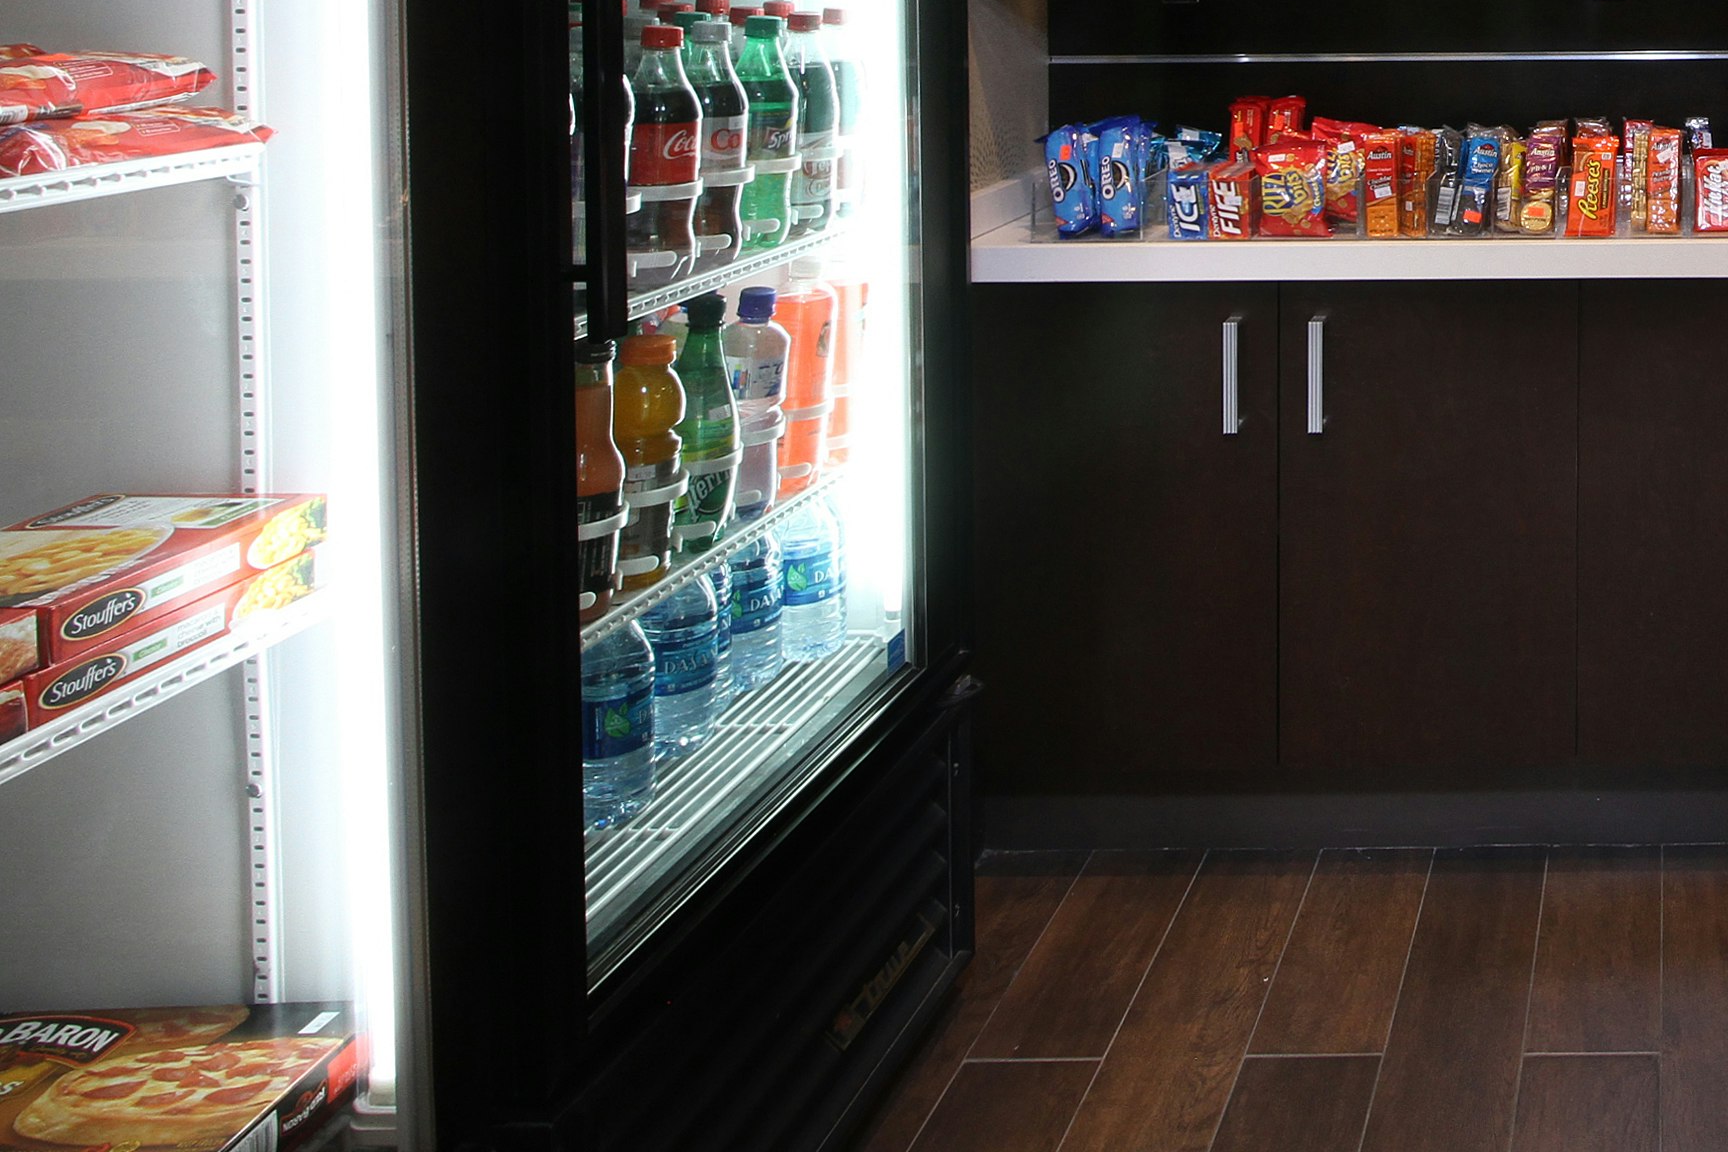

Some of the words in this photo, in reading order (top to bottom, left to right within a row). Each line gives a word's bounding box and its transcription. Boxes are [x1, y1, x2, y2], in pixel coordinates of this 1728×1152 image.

[1367, 151, 1392, 160] Austin
[1473, 147, 1498, 158] Austin
[1048, 158, 1065, 202] OREO
[1101, 156, 1115, 200] OREO
[1262, 173, 1291, 216] RITZ
[1287, 171, 1308, 204] bits
[1578, 160, 1601, 220] Reese's
[1171, 184, 1201, 232] ICE
[1213, 179, 1242, 235] FIRE
[71, 592, 136, 635] Stouffer's
[50, 657, 117, 704] Stouffer's
[0, 1021, 119, 1052] BARON
